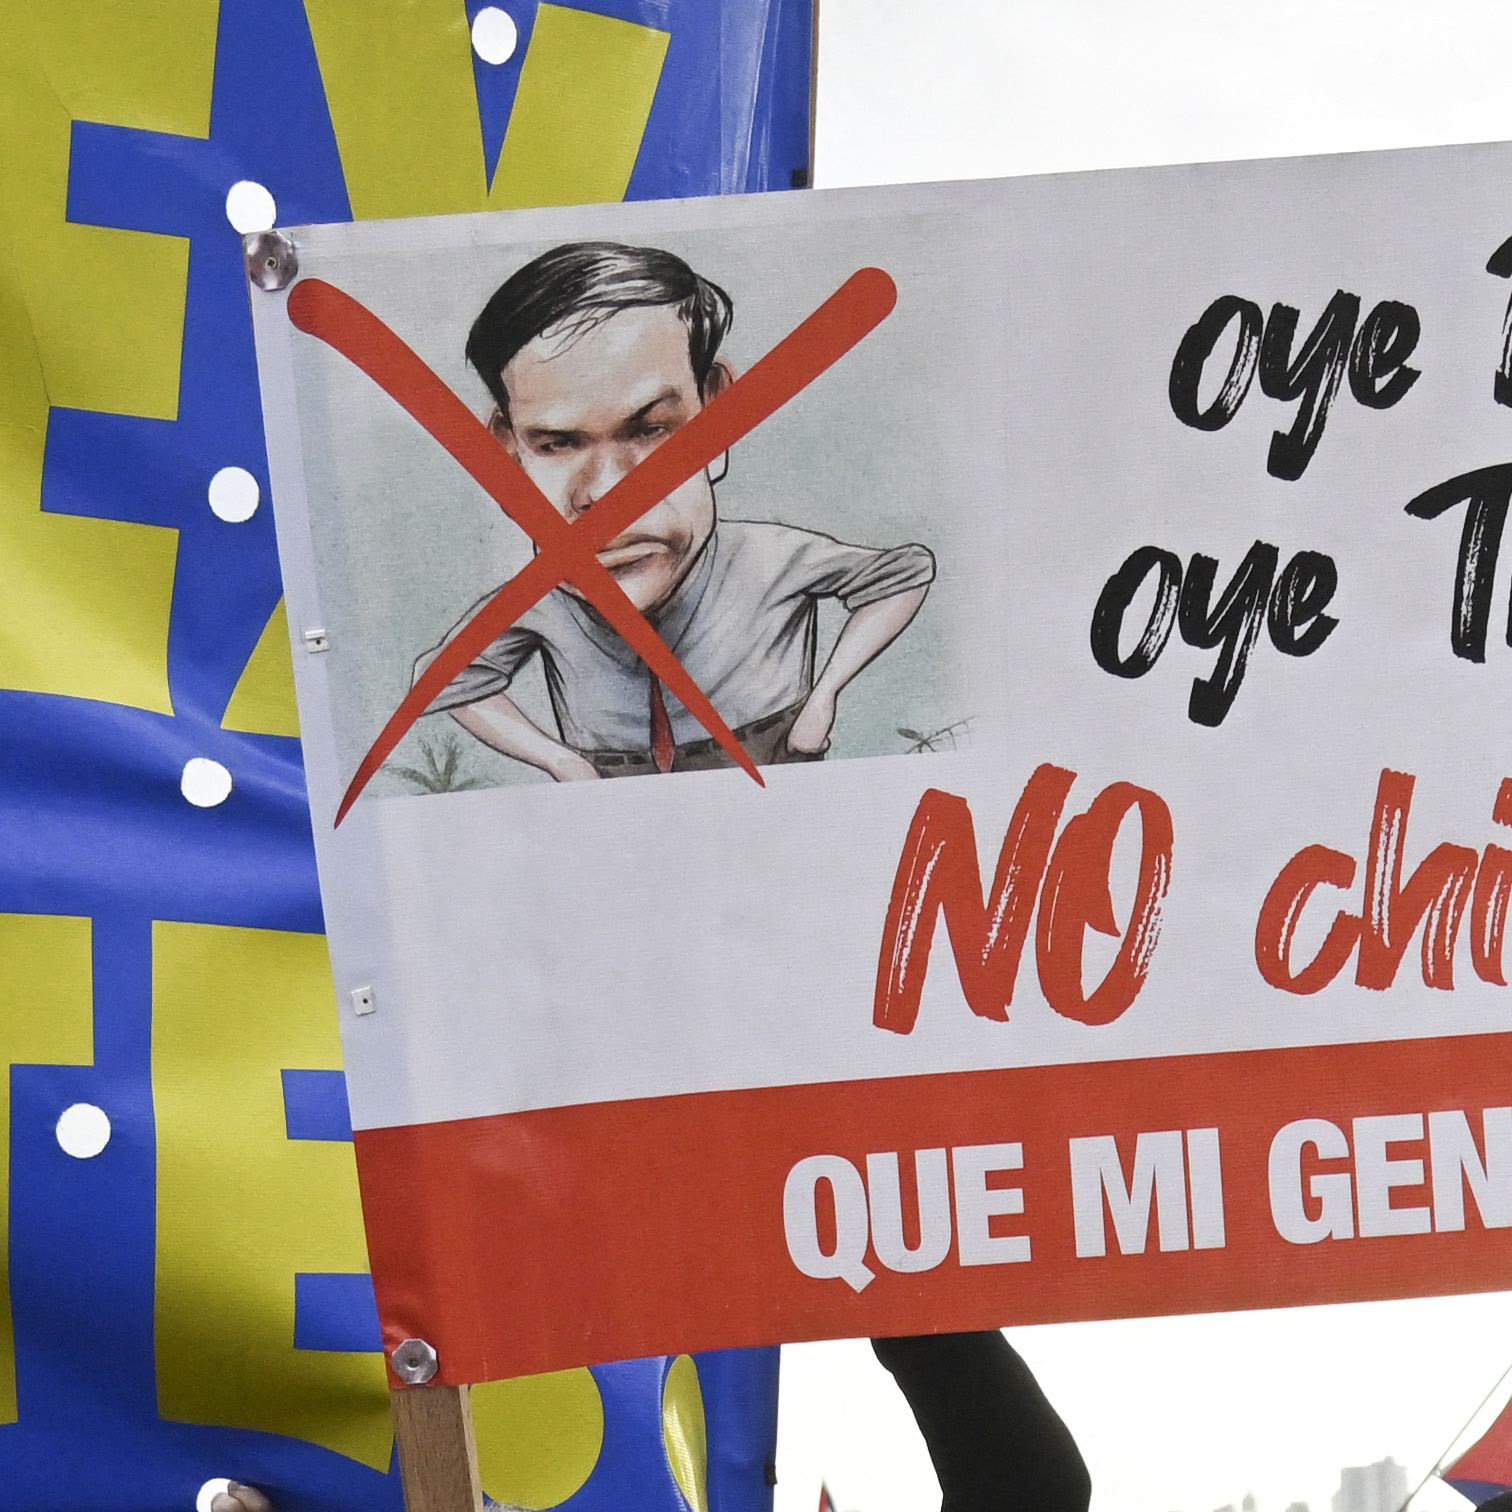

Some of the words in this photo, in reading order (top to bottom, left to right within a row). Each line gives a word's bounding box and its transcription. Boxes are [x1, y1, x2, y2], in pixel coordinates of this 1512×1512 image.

[1168, 288, 1423, 482] oye
[1090, 539, 1341, 728] oye
[873, 762, 1175, 1035] NO
[782, 1142, 1032, 1294] QUE
[1068, 1127, 1226, 1258] MI
